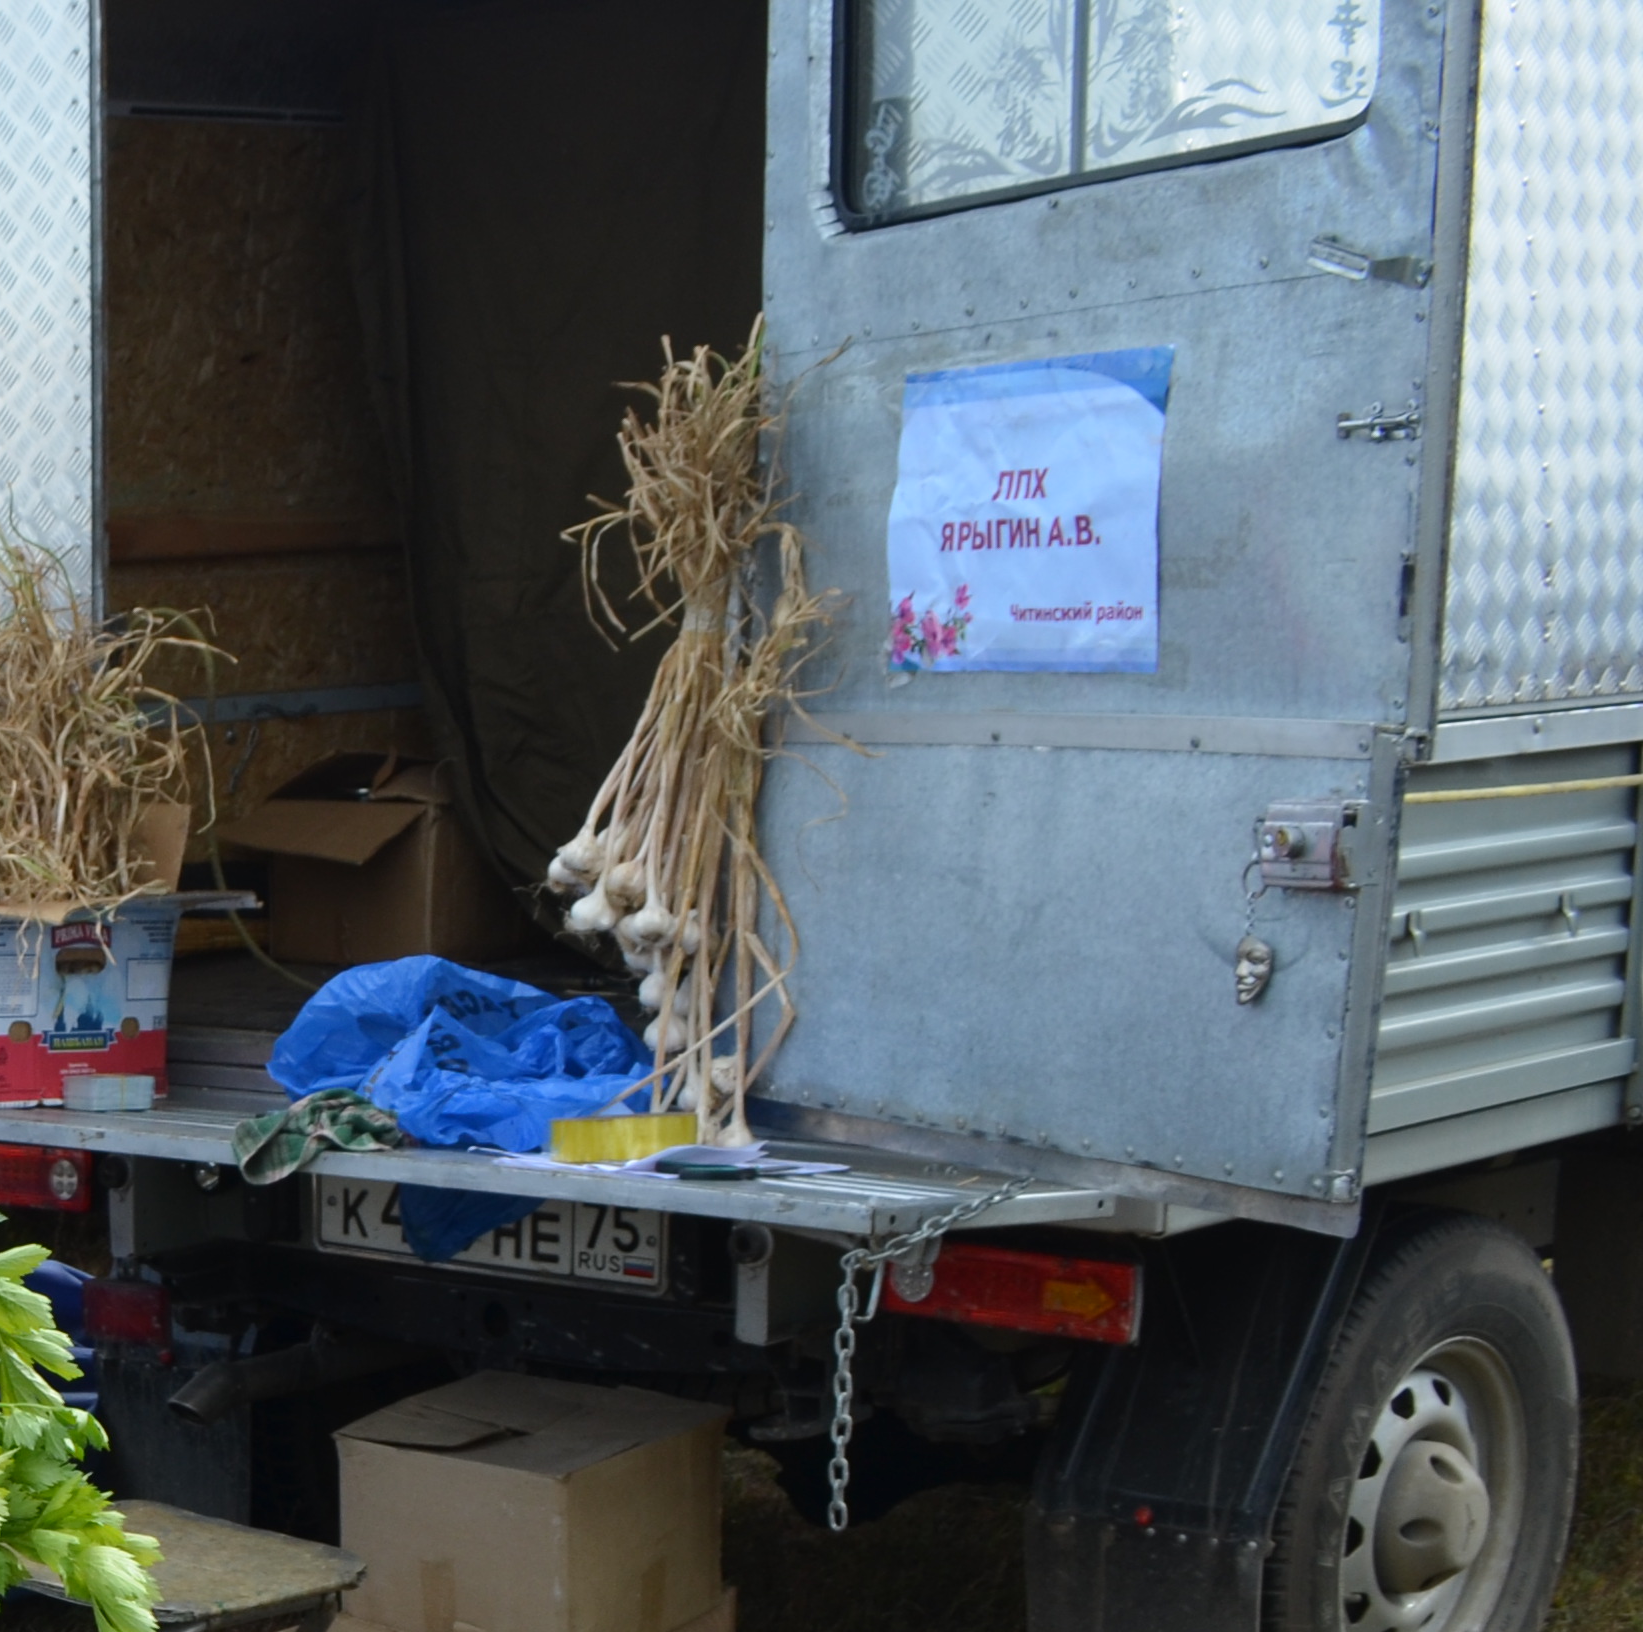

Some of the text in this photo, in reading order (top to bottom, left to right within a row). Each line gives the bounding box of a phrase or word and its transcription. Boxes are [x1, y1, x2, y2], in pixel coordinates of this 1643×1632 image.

[992, 467, 1050, 502] ЛПХ
[940, 517, 1042, 552] ЯРЫГИН
[1009, 600, 1144, 624] Читинский район
[55, 924, 83, 944] PRIMA
[582, 1203, 641, 1254] 75
[578, 1251, 622, 1274] RUS
